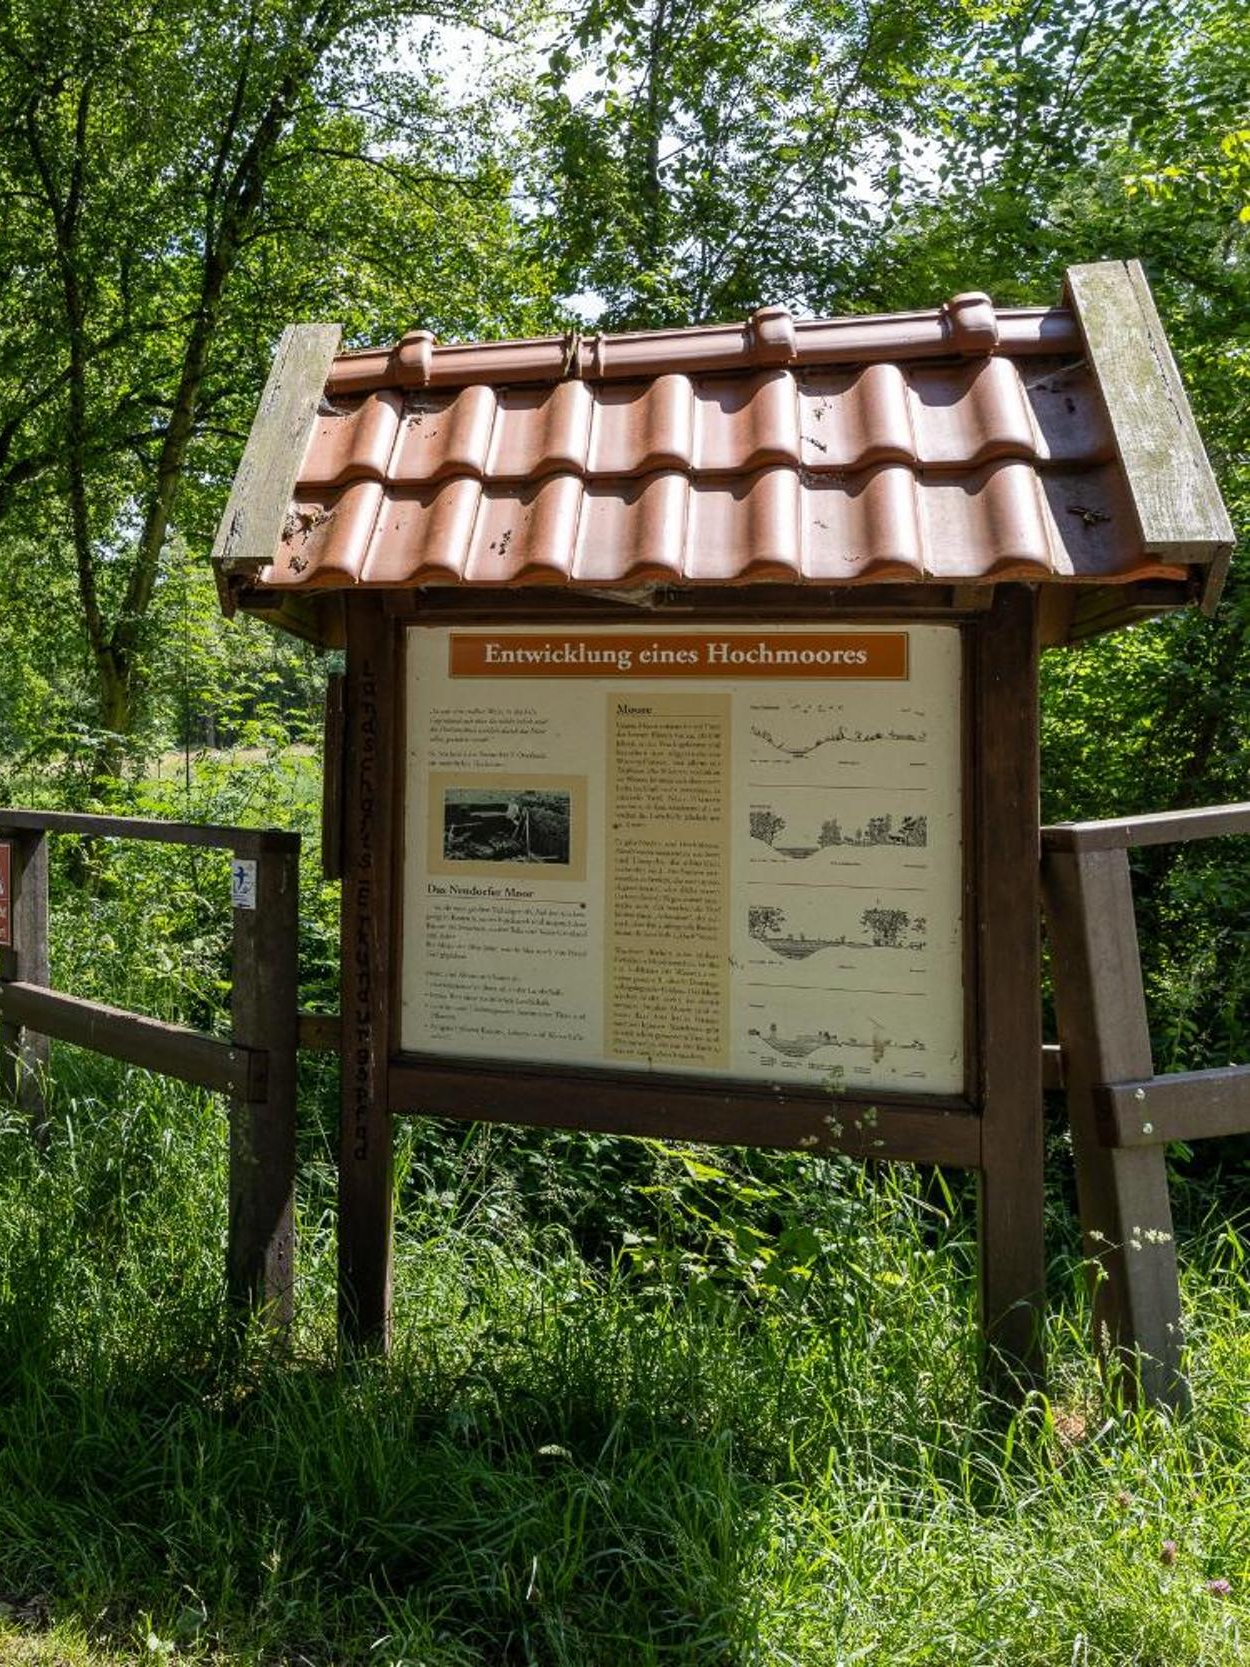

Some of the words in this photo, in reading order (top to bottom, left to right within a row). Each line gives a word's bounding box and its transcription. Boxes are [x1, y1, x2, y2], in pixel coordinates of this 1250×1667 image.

[484, 643, 632, 669] Entwicklung
[639, 643, 698, 665] eines
[705, 642, 868, 665] Hochmoores
[616, 704, 652, 715] Moore
[427, 884, 445, 895] Das
[504, 887, 534, 898] Moor
